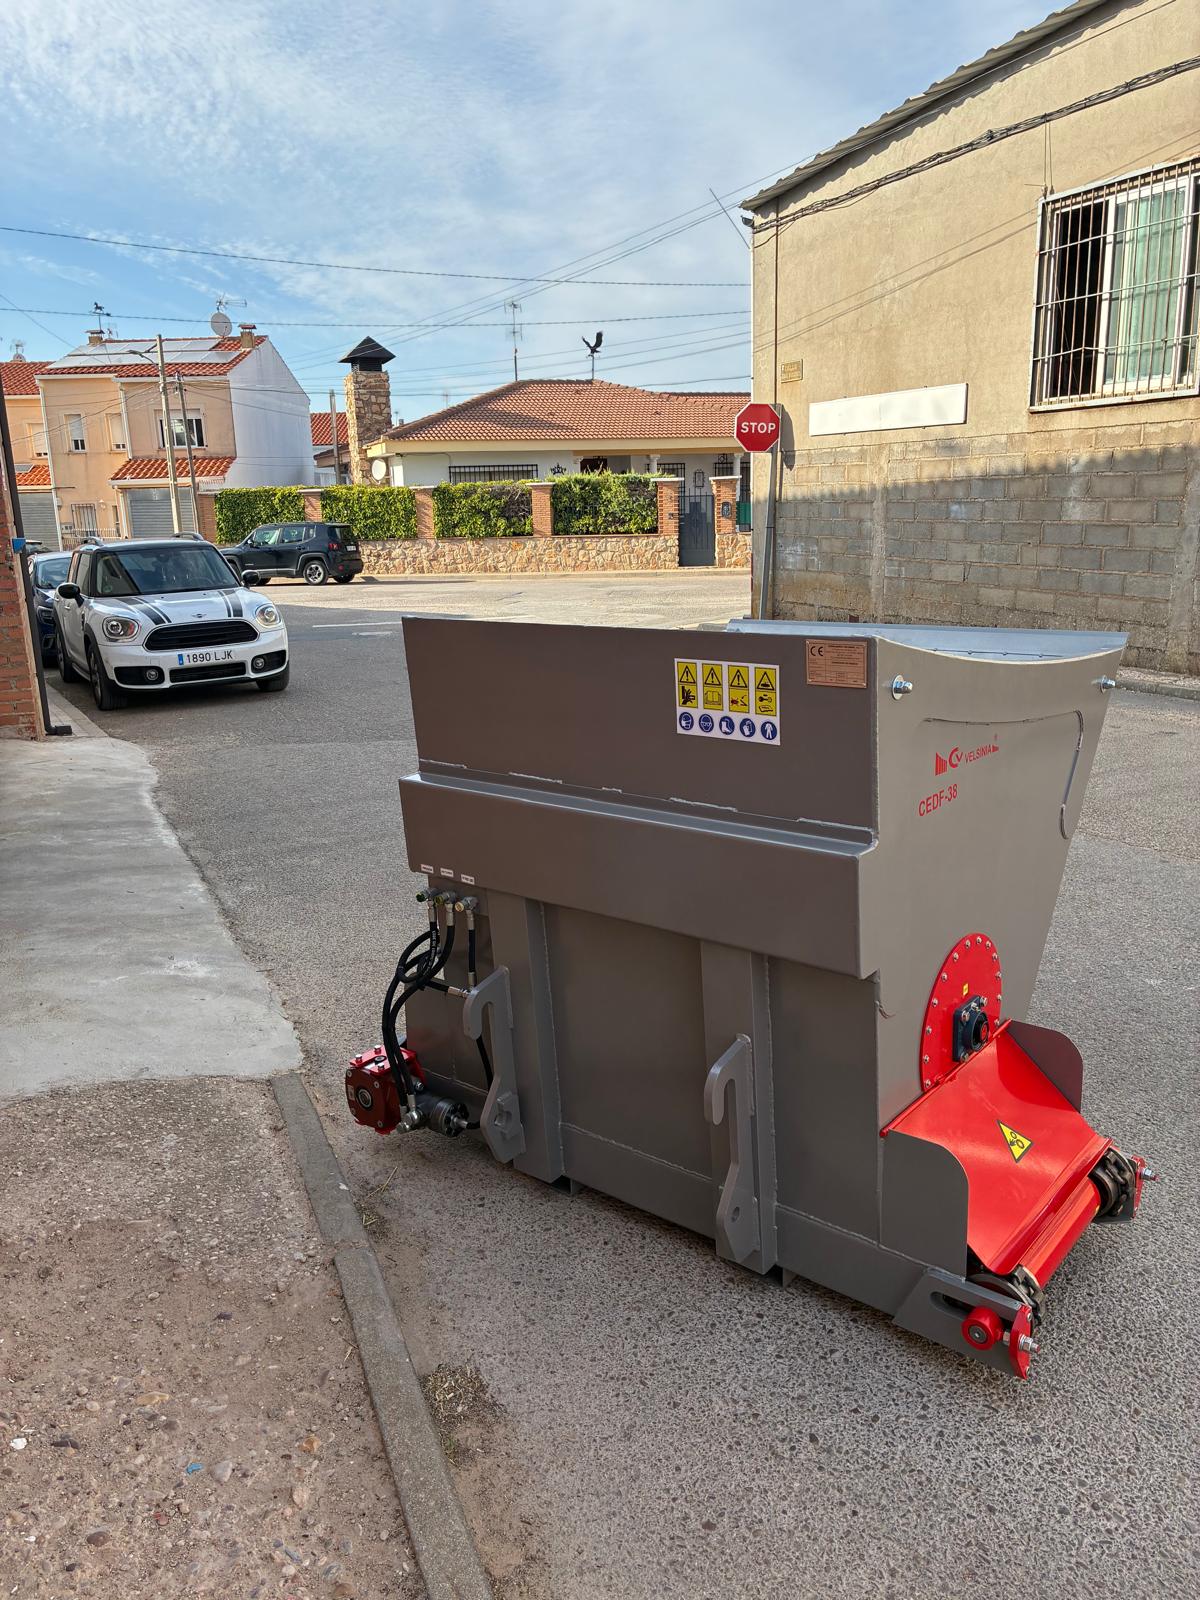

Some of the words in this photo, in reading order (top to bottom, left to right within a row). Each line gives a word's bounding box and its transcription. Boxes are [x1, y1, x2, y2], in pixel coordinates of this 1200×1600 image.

[740, 421, 776, 434] STOP
[186, 652, 211, 664] 1890
[214, 649, 233, 661] LJK
[965, 744, 992, 764] VELSINIA
[918, 783, 958, 817] CEDF-38
